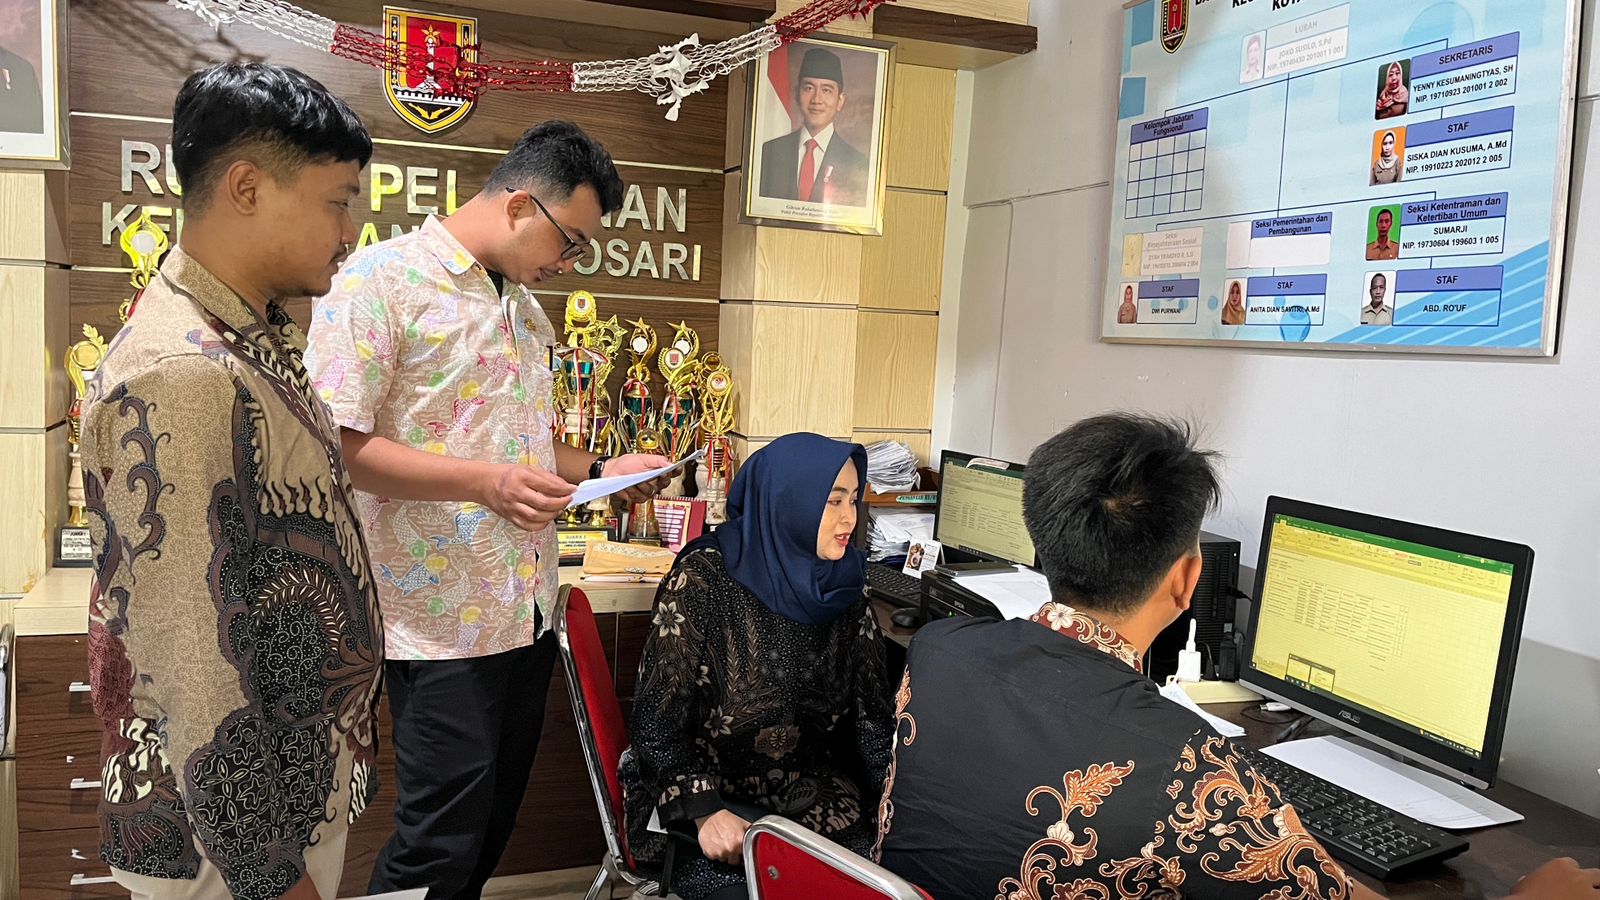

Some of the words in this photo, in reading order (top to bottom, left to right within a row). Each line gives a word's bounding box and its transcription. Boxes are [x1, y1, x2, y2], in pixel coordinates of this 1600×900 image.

[1295, 20, 1318, 33] LURAH
[1279, 48, 1294, 59] JOKO
[1438, 44, 1493, 65] SEKRETARIS
[1413, 81, 1436, 93] YENNY
[1436, 67, 1501, 88] KESUMANINGTYAS,
[1503, 64, 1514, 74] SH
[1415, 94, 1428, 103] NIP.
[1430, 89, 1460, 100] 19710923
[1462, 83, 1487, 94] 201001
[1488, 80, 1493, 89] 2
[1494, 78, 1508, 88] 002
[1143, 119, 1170, 131] Kelompok
[1171, 113, 1194, 124] Jabatan
[1153, 123, 1184, 136] Fungsional
[1447, 121, 1469, 133] STAF
[1406, 152, 1429, 162] SISKA
[1430, 150, 1449, 160] DIAN
[1450, 144, 1486, 156] KUSUMA,
[1487, 140, 1507, 150] A.Md
[1405, 165, 1419, 174] NIP.
[1421, 160, 1453, 172] 19910223
[1455, 156, 1481, 168] 202012
[1482, 155, 1487, 164] 2
[1489, 153, 1503, 163] 005
[1407, 203, 1429, 214] Seksi
[1430, 199, 1482, 212] Ketentraman
[1485, 196, 1501, 206] dan
[1255, 220, 1272, 229] Seksi
[1272, 217, 1314, 228] Pemerintahan
[1315, 214, 1328, 222] dan
[1417, 211, 1458, 223] Ketertiban
[1460, 208, 1488, 218] Umum
[1268, 225, 1312, 236] Pembangunan
[1433, 225, 1468, 235] SUMARJI
[1402, 241, 1415, 250] NIP.
[1418, 238, 1450, 249] 19730604
[1452, 237, 1477, 247] 199603
[1479, 236, 1484, 244] 1
[1485, 235, 1499, 244] 005
[573, 237, 702, 281] OSARI
[1276, 281, 1294, 290] STAF
[1436, 275, 1458, 285] STAF
[1306, 305, 1320, 313] A.Md
[1422, 305, 1441, 313] ABD.
[1338, 709, 1361, 724] ASUS
